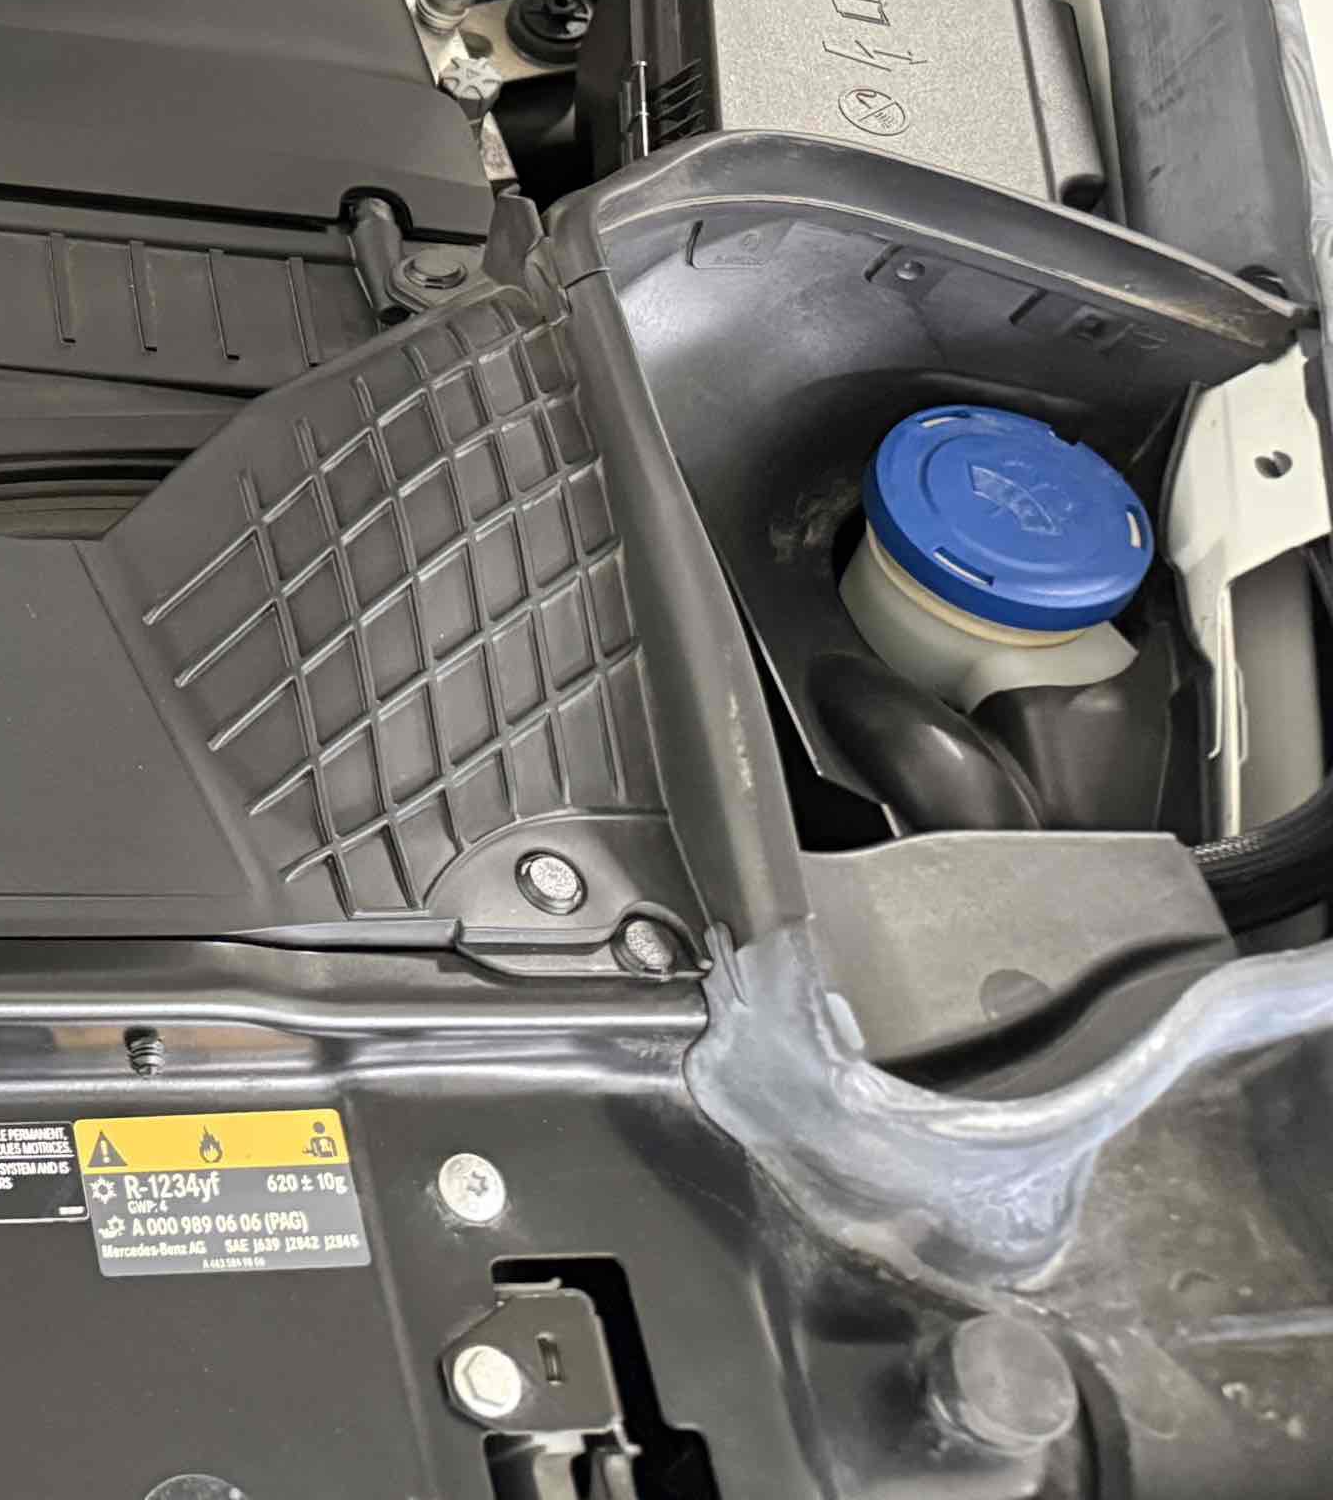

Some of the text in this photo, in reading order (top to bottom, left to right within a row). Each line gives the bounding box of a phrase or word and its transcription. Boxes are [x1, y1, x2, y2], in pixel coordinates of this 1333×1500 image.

[37, 1162, 57, 1174] AND
[59, 1161, 70, 1174] IS
[124, 1171, 221, 1202] R-1234yf
[267, 1172, 349, 1195] 620 ± 10g
[159, 1200, 168, 1212] 4
[133, 1210, 309, 1236] A 000 989 06 06 (PAG)
[101, 1234, 360, 1259] Mercedes-Benz AG SAE J639 J2842 J2845
